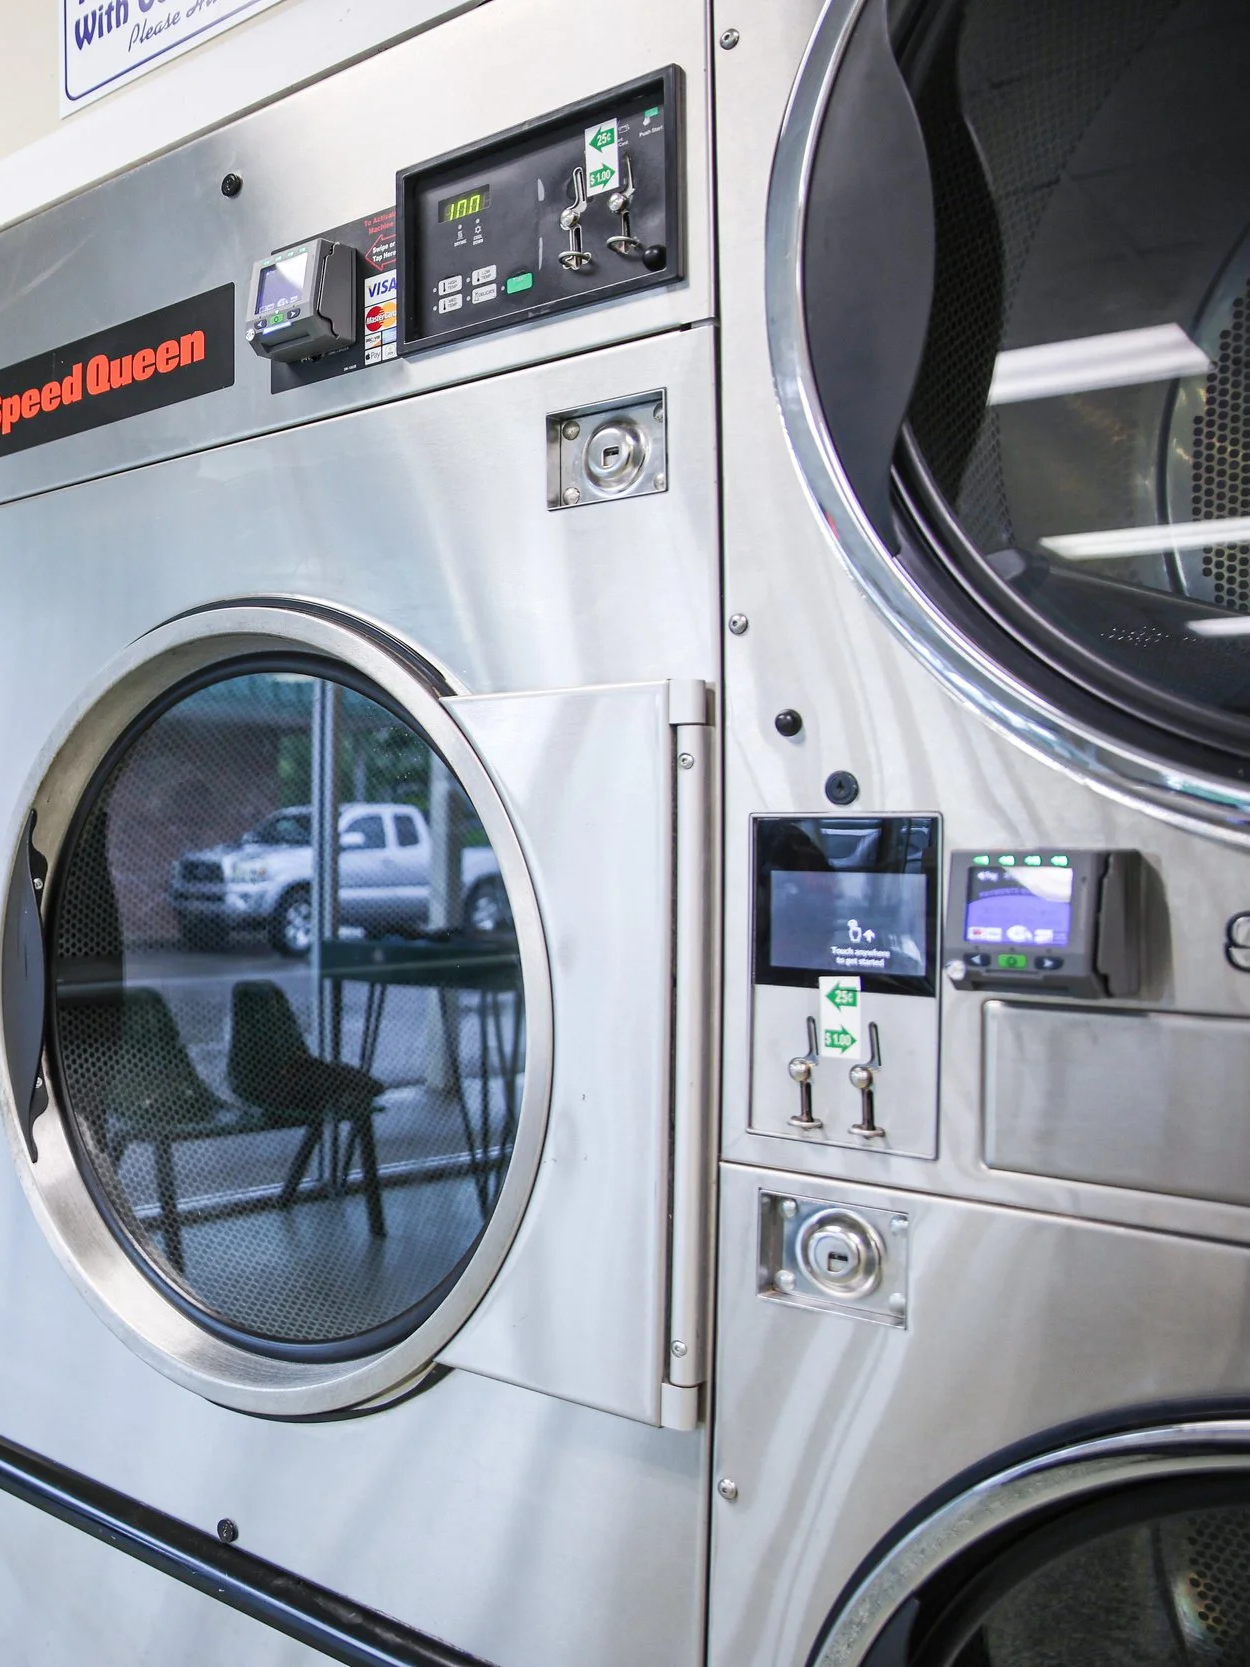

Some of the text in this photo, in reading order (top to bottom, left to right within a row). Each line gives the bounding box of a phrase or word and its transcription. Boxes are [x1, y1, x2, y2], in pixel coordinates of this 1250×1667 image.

[74, 0, 130, 51] With
[128, 10, 182, 52] Please
[596, 132, 612, 146] 25¢
[372, 243, 389, 254] Swipe
[368, 277, 397, 298] VISA
[370, 350, 381, 360] Pay
[85, 329, 206, 396] Queen
[830, 946, 891, 959] Touch anywhere
[835, 956, 885, 968] to get started
[834, 990, 854, 1004] 25¢
